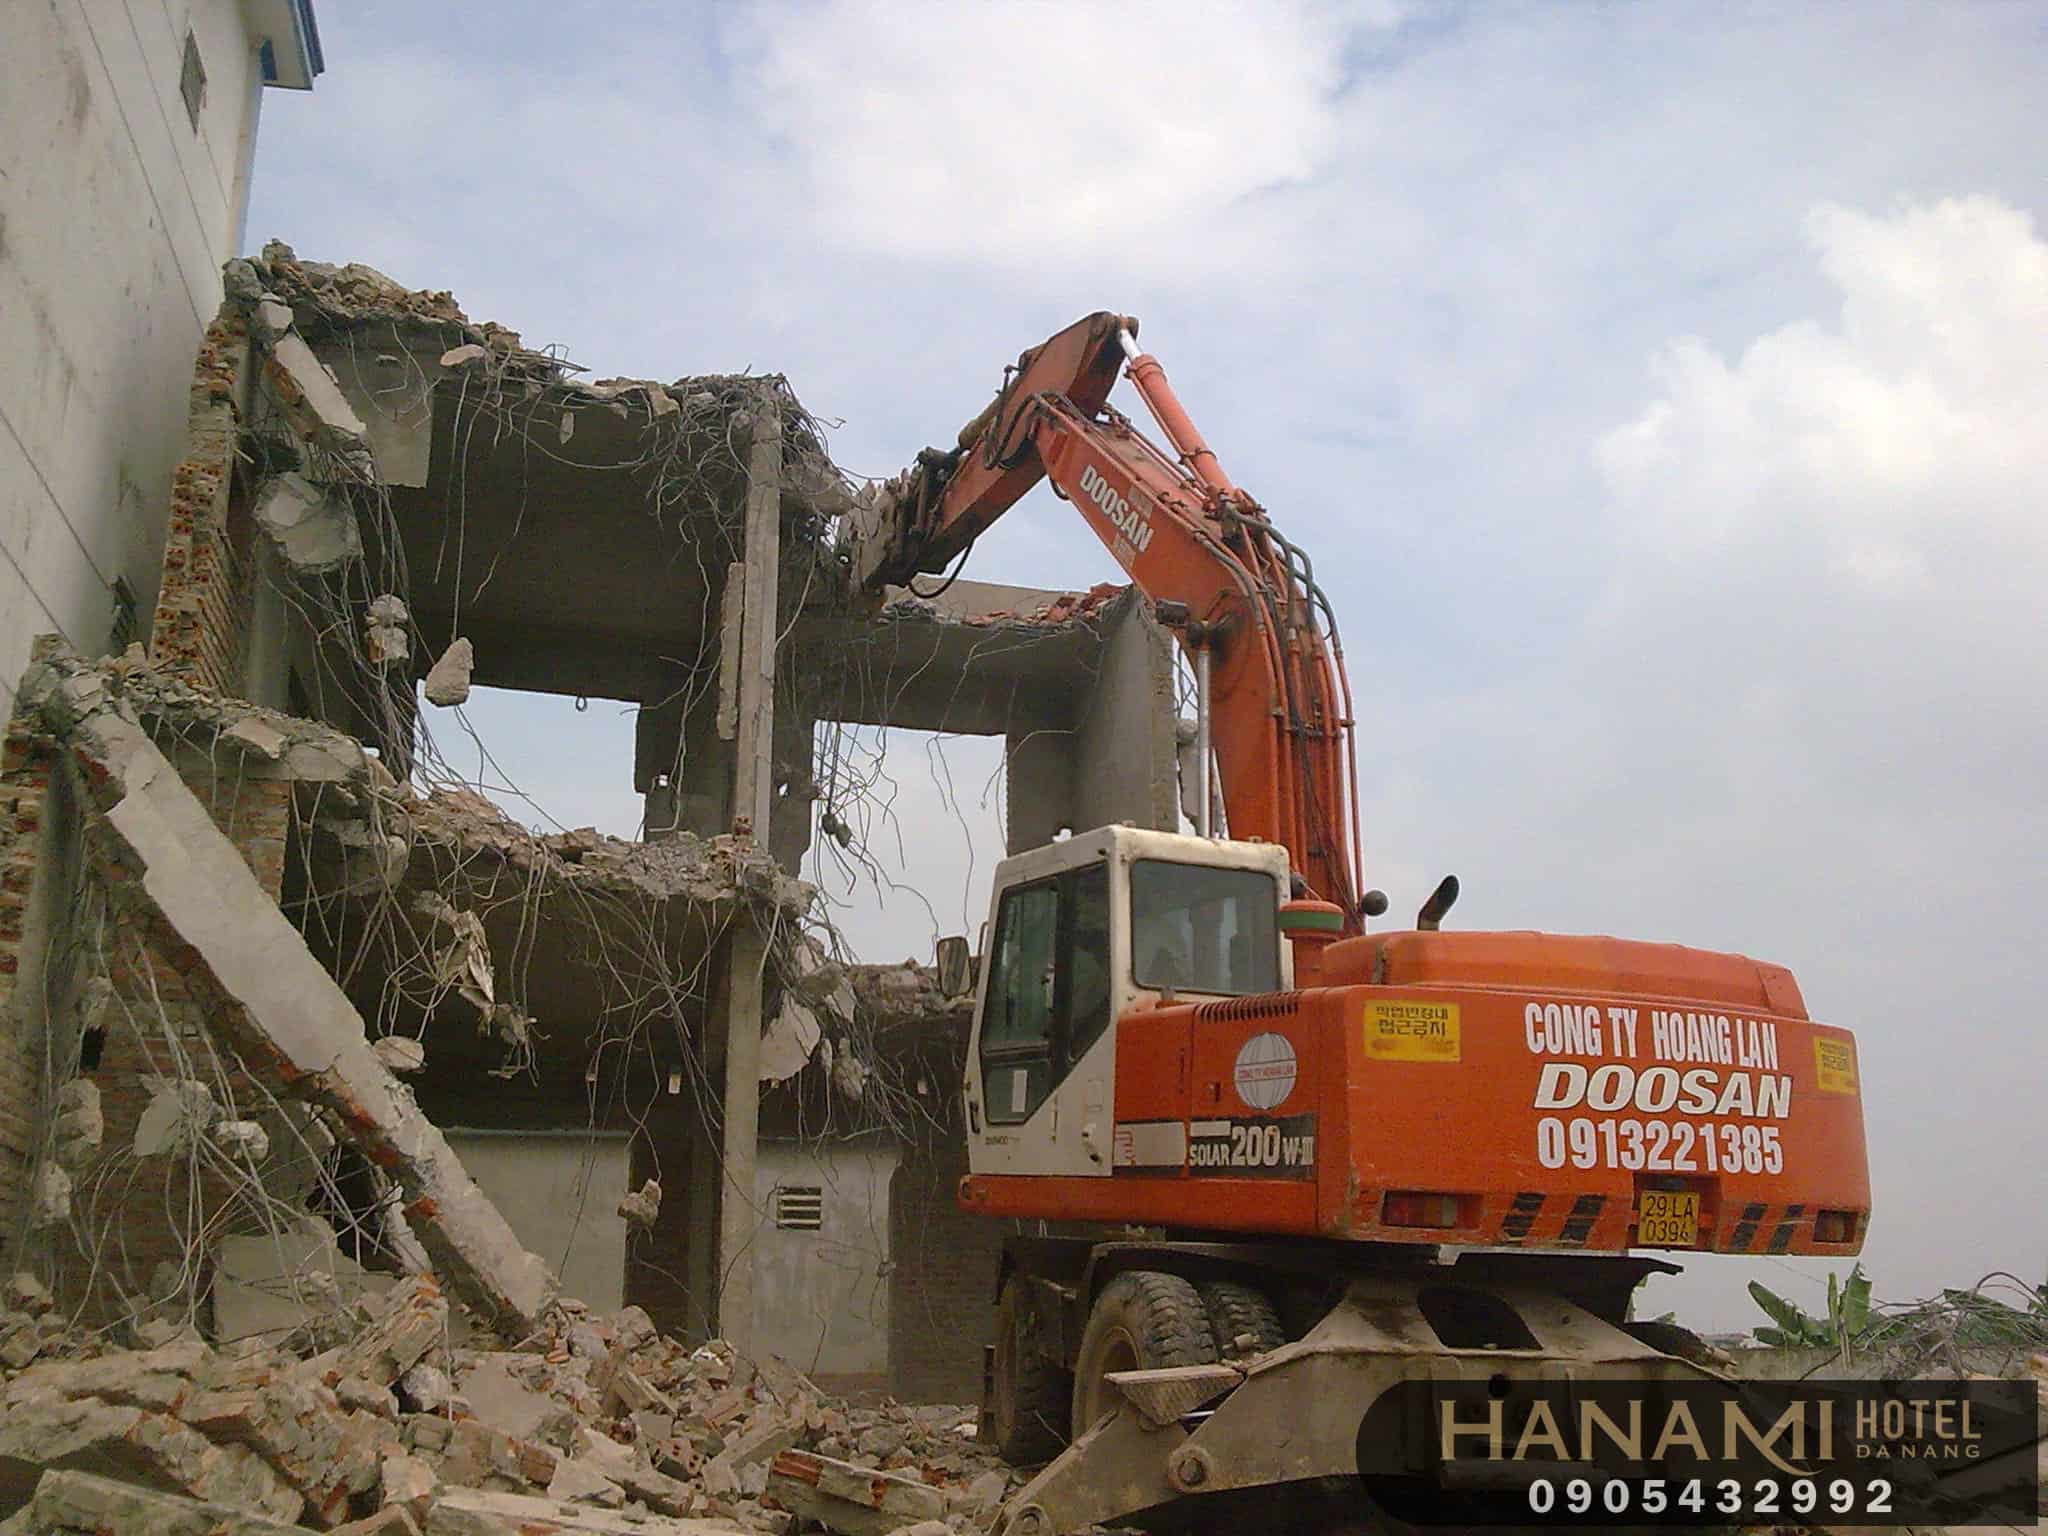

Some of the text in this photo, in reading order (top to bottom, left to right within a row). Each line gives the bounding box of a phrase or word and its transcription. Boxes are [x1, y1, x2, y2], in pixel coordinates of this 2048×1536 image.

[1080, 464, 1154, 552] DOOSAN
[1525, 1002, 1778, 1070] CONG TY HOANG LAN
[1534, 1062, 1792, 1119] DOOSAN
[1189, 1143, 1230, 1166] SOLAR
[1231, 1125, 1281, 1167] 200
[1536, 1117, 1784, 1175] 0913221385
